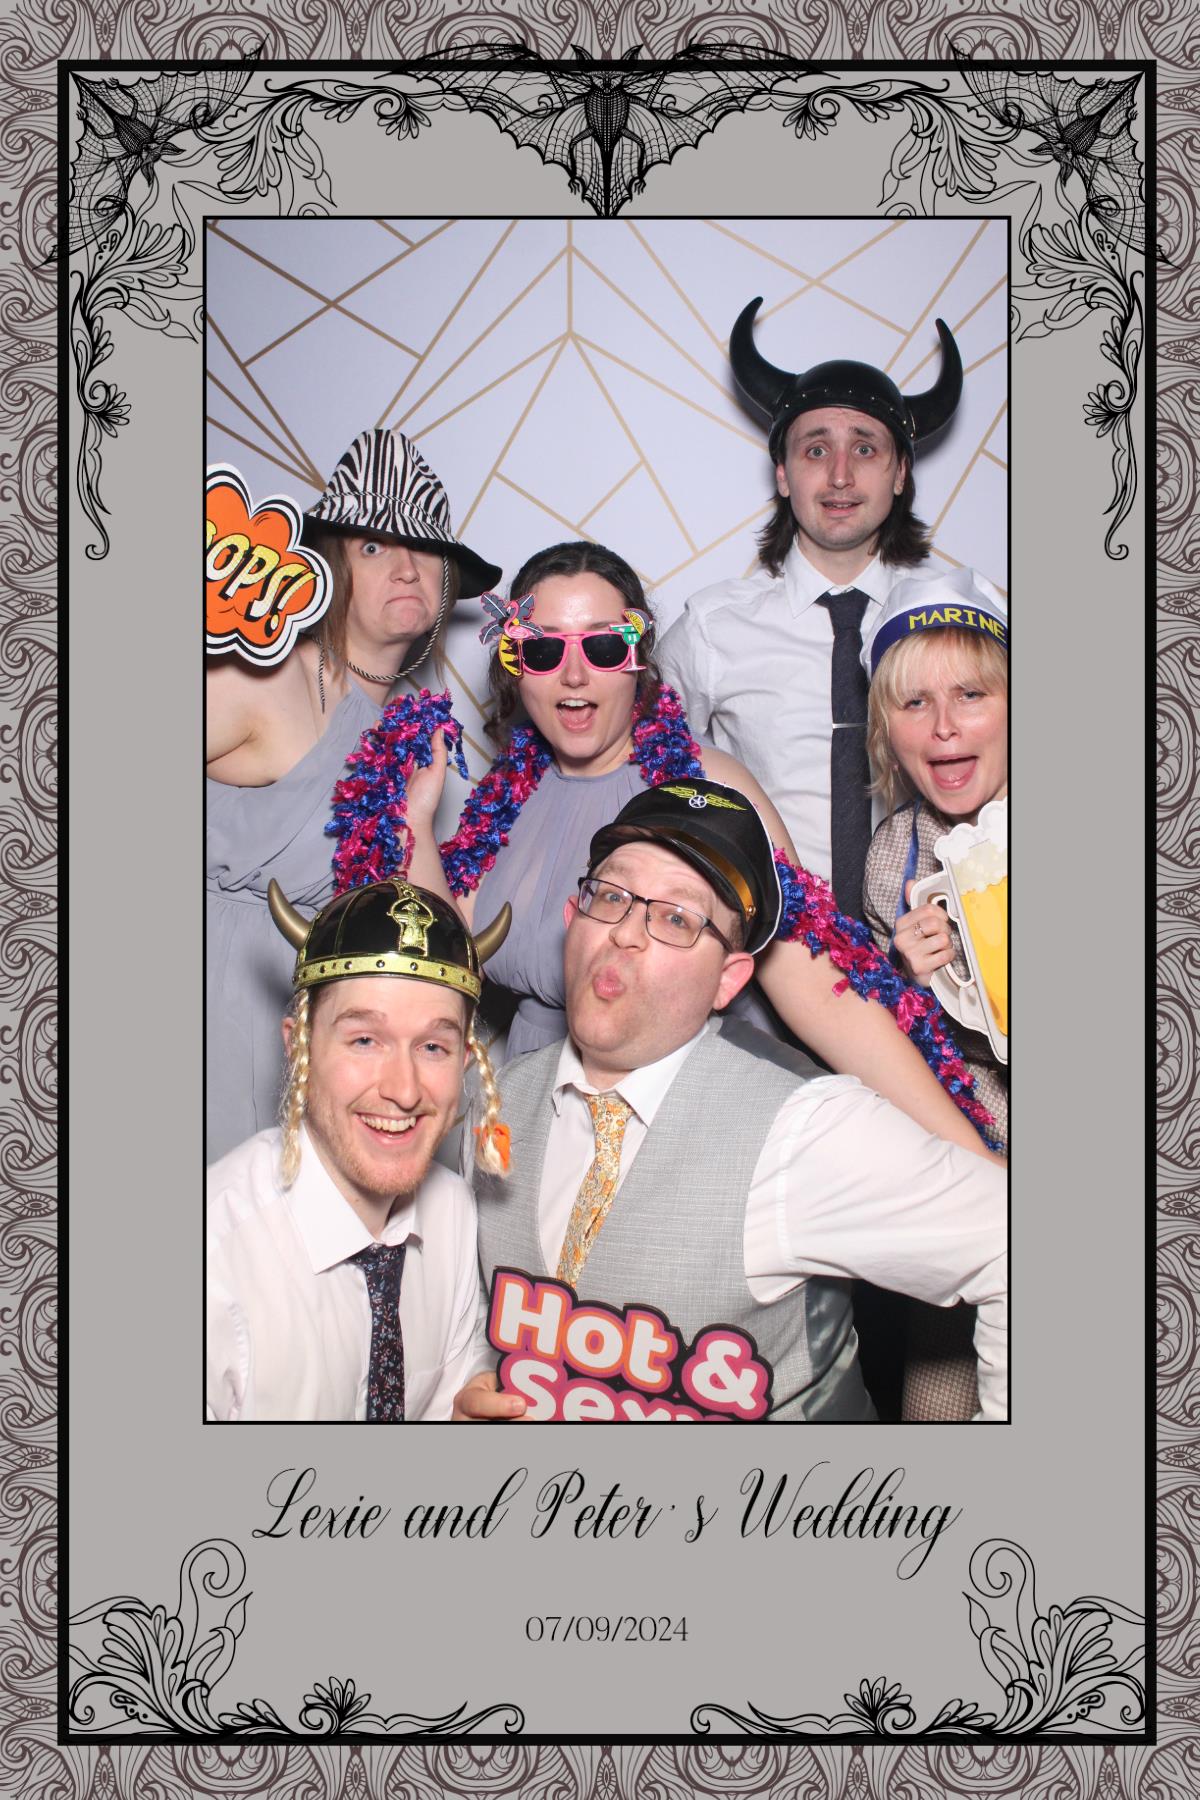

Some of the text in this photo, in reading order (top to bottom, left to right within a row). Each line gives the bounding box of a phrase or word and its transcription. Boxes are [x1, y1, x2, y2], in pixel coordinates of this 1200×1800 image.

[206, 518, 319, 636] OPS!
[909, 607, 1007, 643] MARINE
[496, 1278, 759, 1411] Hot &
